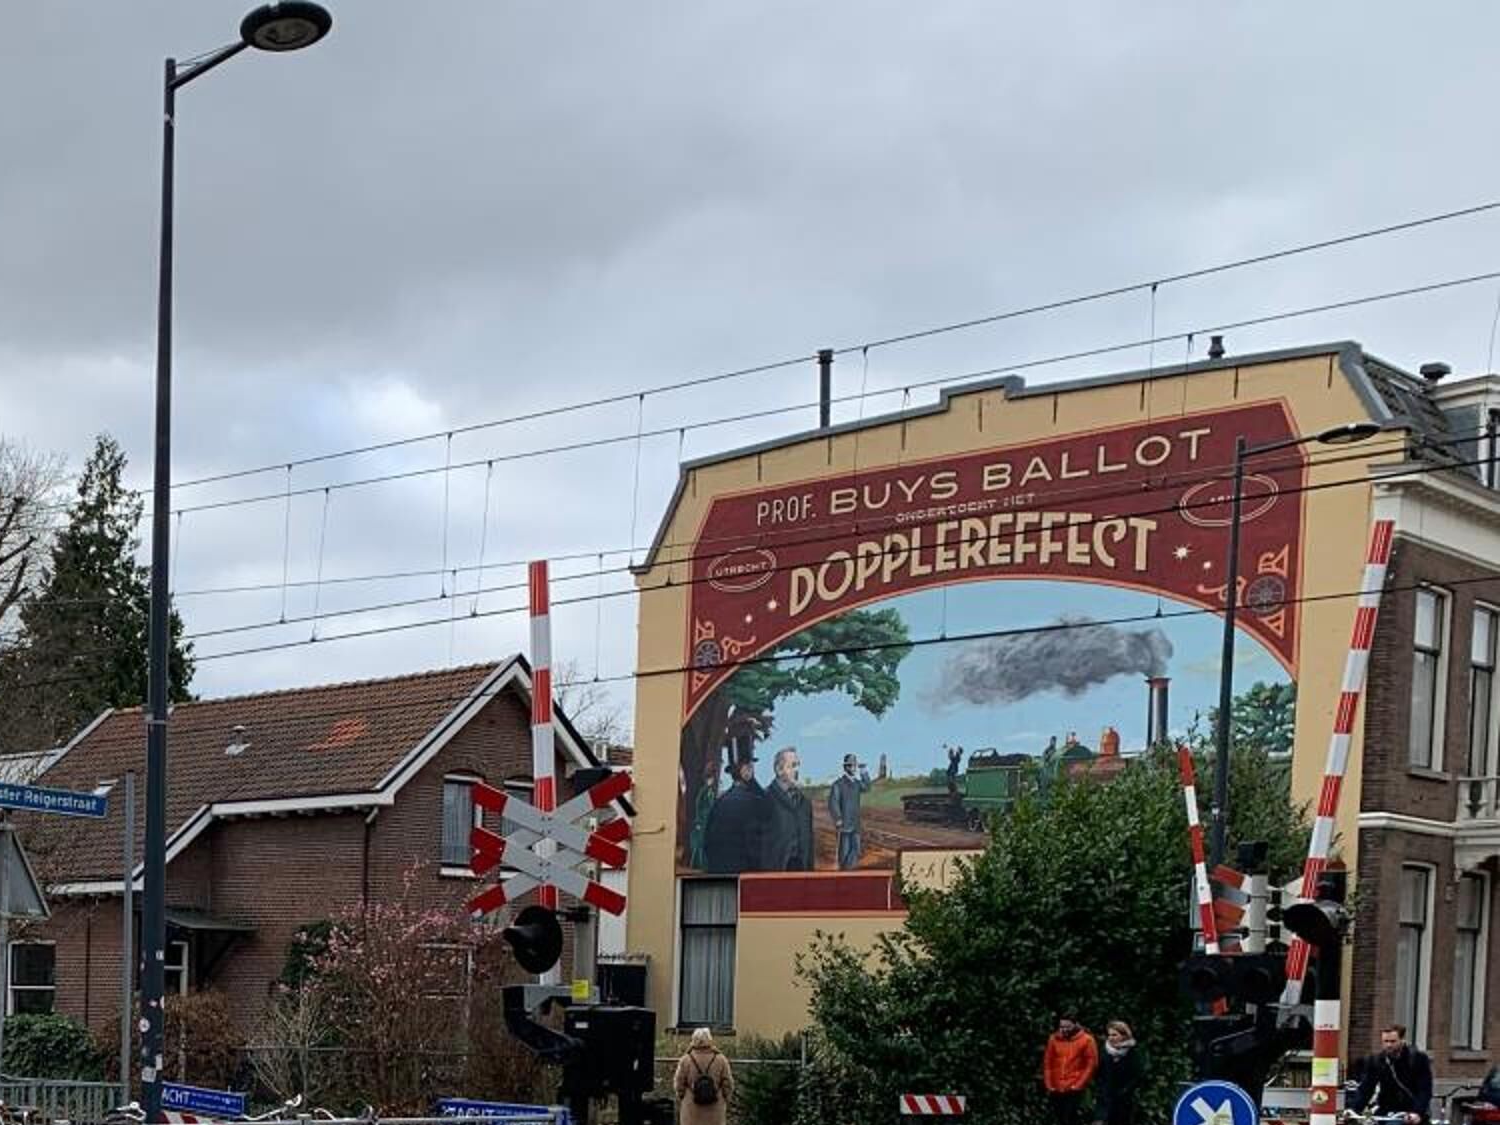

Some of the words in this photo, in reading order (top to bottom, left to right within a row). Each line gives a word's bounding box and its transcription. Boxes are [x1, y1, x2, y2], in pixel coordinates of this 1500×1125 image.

[757, 494, 817, 526] PROF.
[830, 471, 959, 515] BUYS
[982, 427, 1212, 492] BALLOT
[715, 561, 769, 577] UTRECHT
[789, 511, 1157, 616] DOPPLEREFFECT
[24, 790, 98, 812] Reigerstraat
[161, 1087, 190, 1105] ACHT
